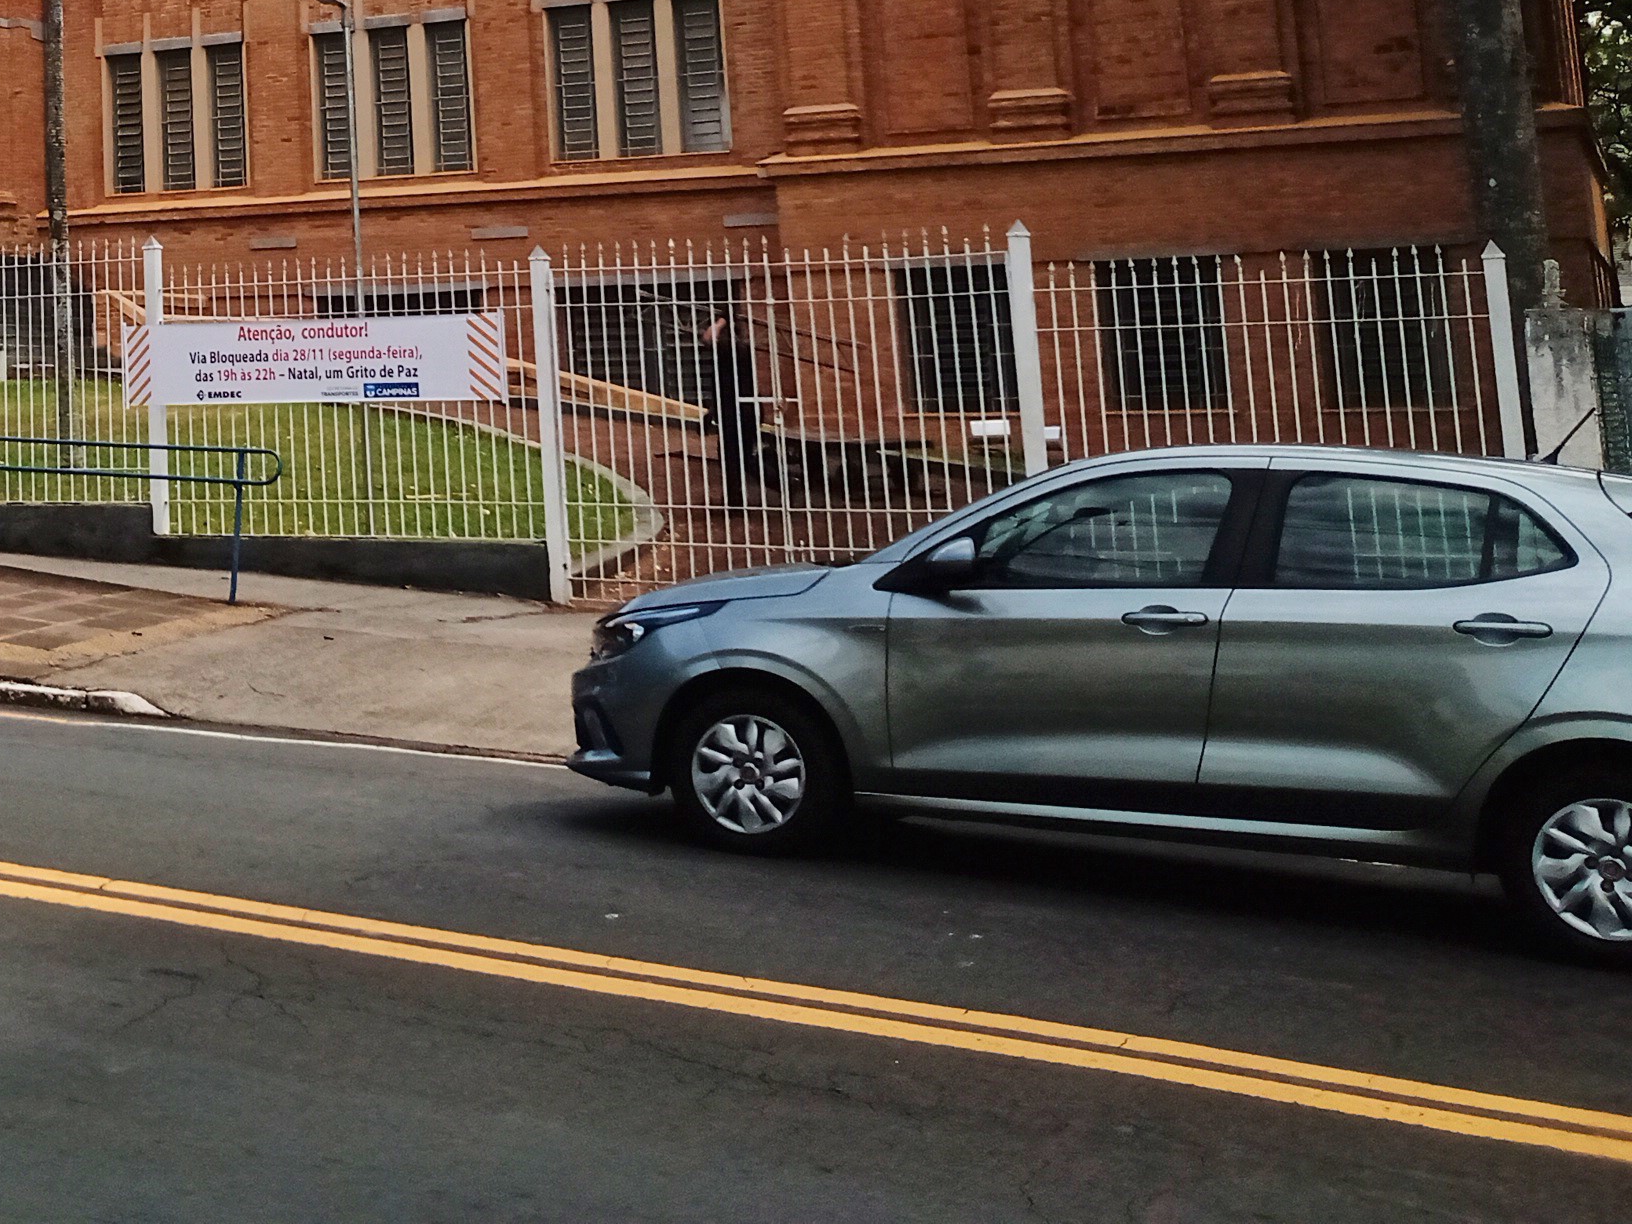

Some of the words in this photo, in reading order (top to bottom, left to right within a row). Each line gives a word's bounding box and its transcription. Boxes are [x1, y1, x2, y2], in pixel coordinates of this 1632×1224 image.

[237, 325, 295, 344] Atenção,
[301, 322, 368, 339] condutor!
[189, 351, 207, 364] Via
[209, 349, 269, 366] Bloqueada
[272, 349, 289, 361] dia
[292, 348, 324, 361] 28/11
[328, 346, 422, 363] (segunda-feira),
[194, 369, 214, 382] das
[217, 369, 237, 381] 19h
[240, 368, 252, 381] às
[255, 367, 276, 380] 22h
[288, 366, 322, 381] Natal,
[325, 369, 343, 379] um
[346, 365, 376, 379] Grito
[379, 364, 394, 378] de
[397, 365, 419, 378] Paz
[208, 391, 242, 399] EMDEC
[376, 387, 418, 396] CAMPINAS
